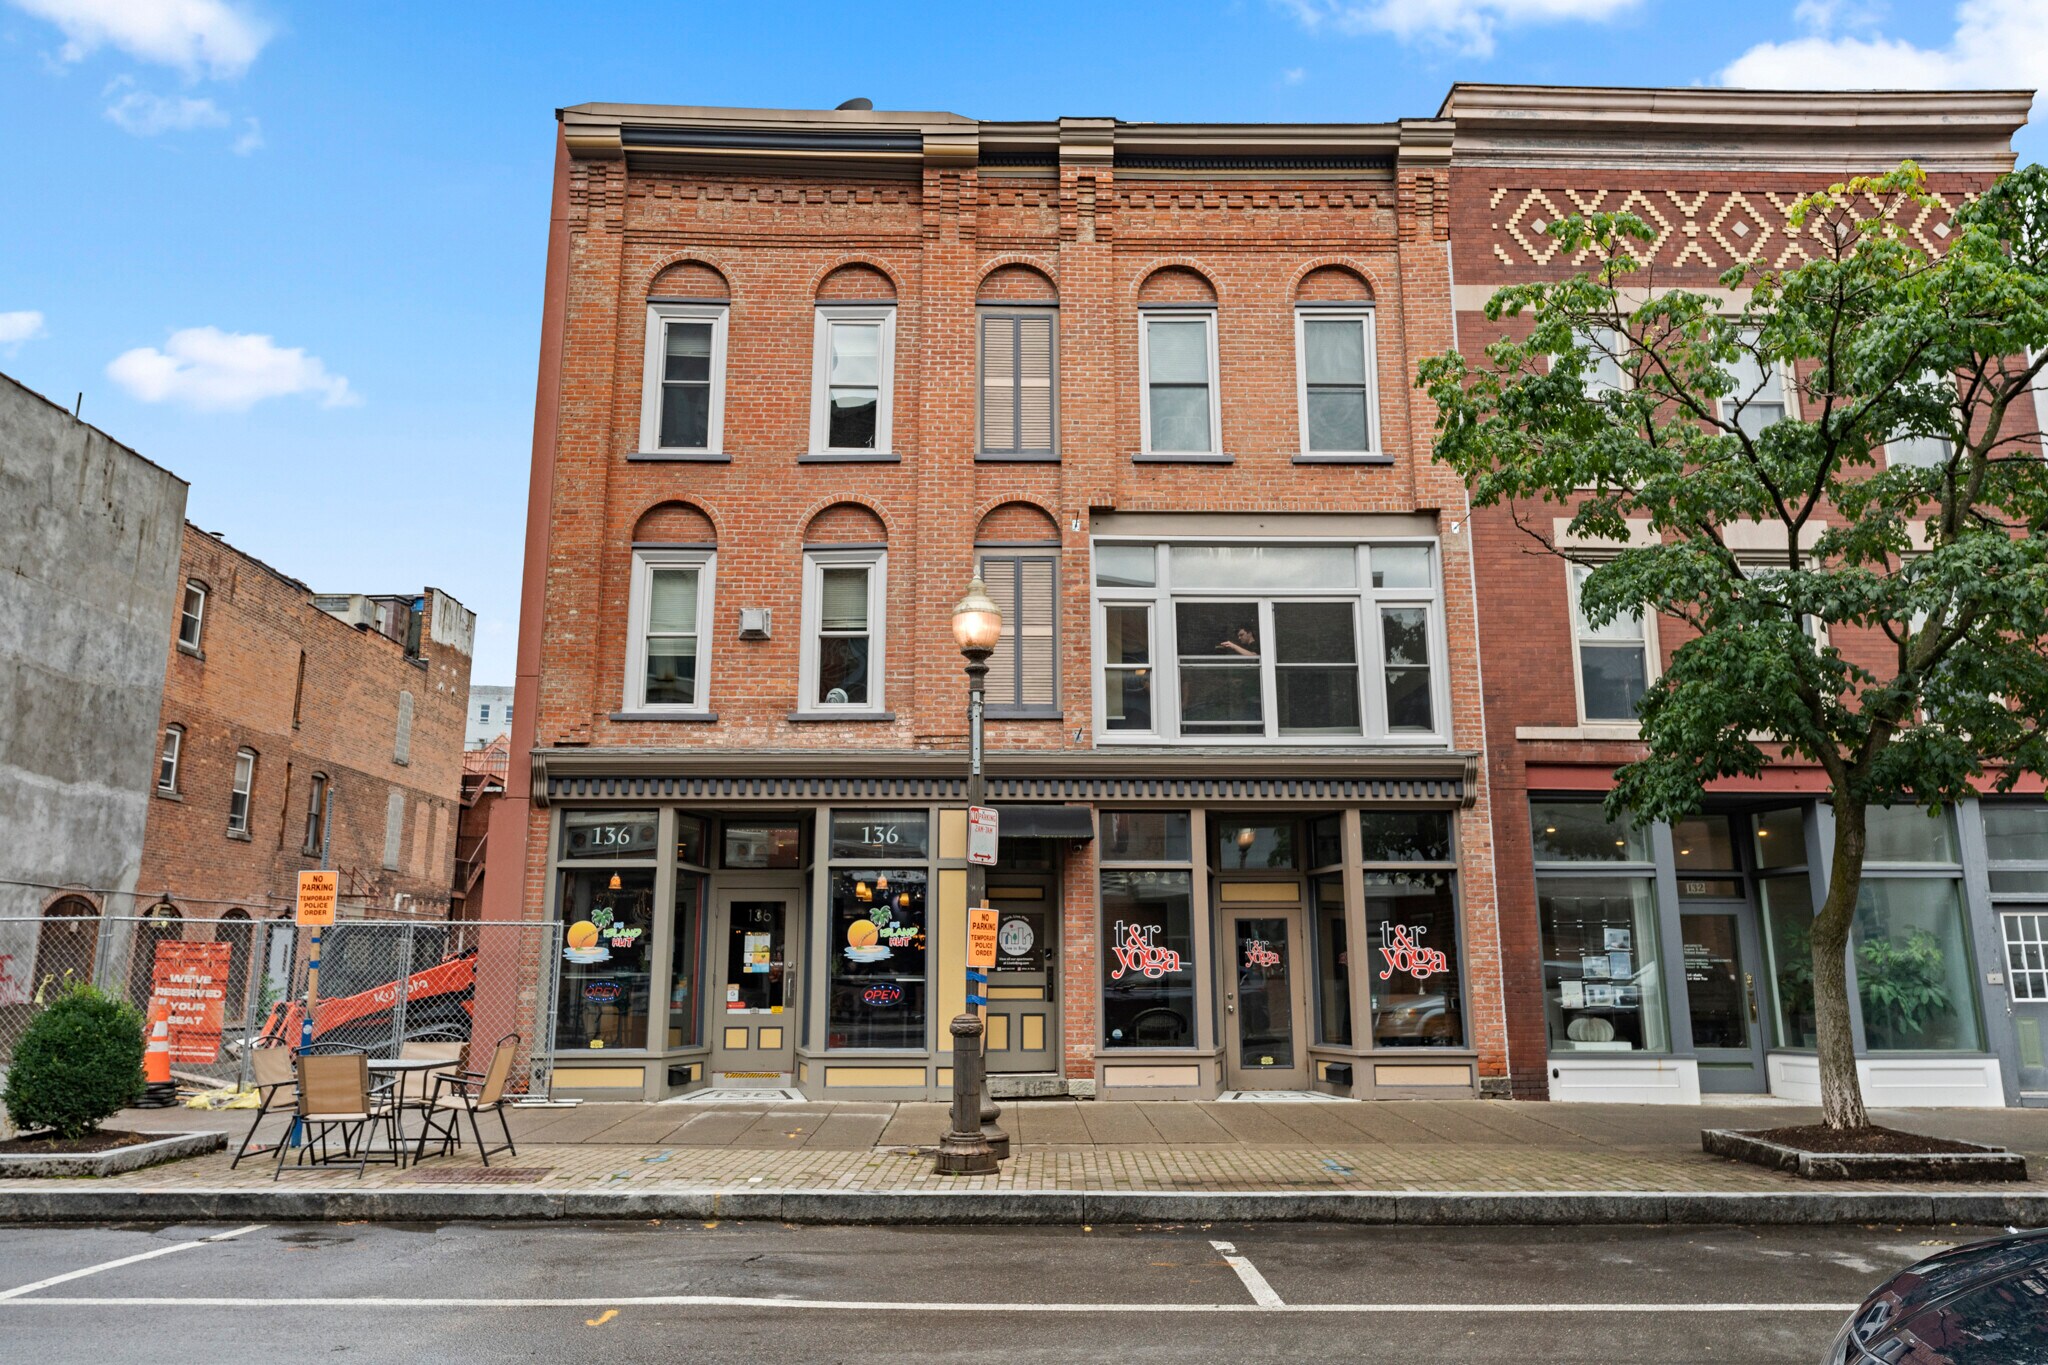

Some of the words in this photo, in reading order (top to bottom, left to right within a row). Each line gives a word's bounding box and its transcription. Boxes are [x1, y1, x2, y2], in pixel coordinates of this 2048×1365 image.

[971, 810, 979, 821] NO
[979, 813, 996, 822] PARKING
[592, 826, 630, 845] 136
[861, 826, 899, 845] 136
[1688, 883, 1704, 892] 132
[748, 908, 771, 922] 136
[981, 913, 989, 921] NO
[603, 927, 642, 938] ISLAND
[880, 926, 918, 938] ISLAND
[972, 922, 995, 931] PARKING
[1114, 919, 1161, 950] t&r
[1380, 920, 1427, 951] t&r
[612, 936, 635, 948] HUT
[889, 935, 911, 947] HUT
[1245, 938, 1270, 953] t&r
[1112, 946, 1182, 979] yoga
[1245, 950, 1281, 968] yoga
[1378, 946, 1449, 980] yoga
[169, 974, 212, 984] WE'VE
[154, 987, 223, 999] RESERVED
[585, 986, 622, 998] OPEN
[864, 989, 900, 1001] OPEN
[170, 1001, 206, 1011] YOUR
[167, 1016, 203, 1025] SEAT
